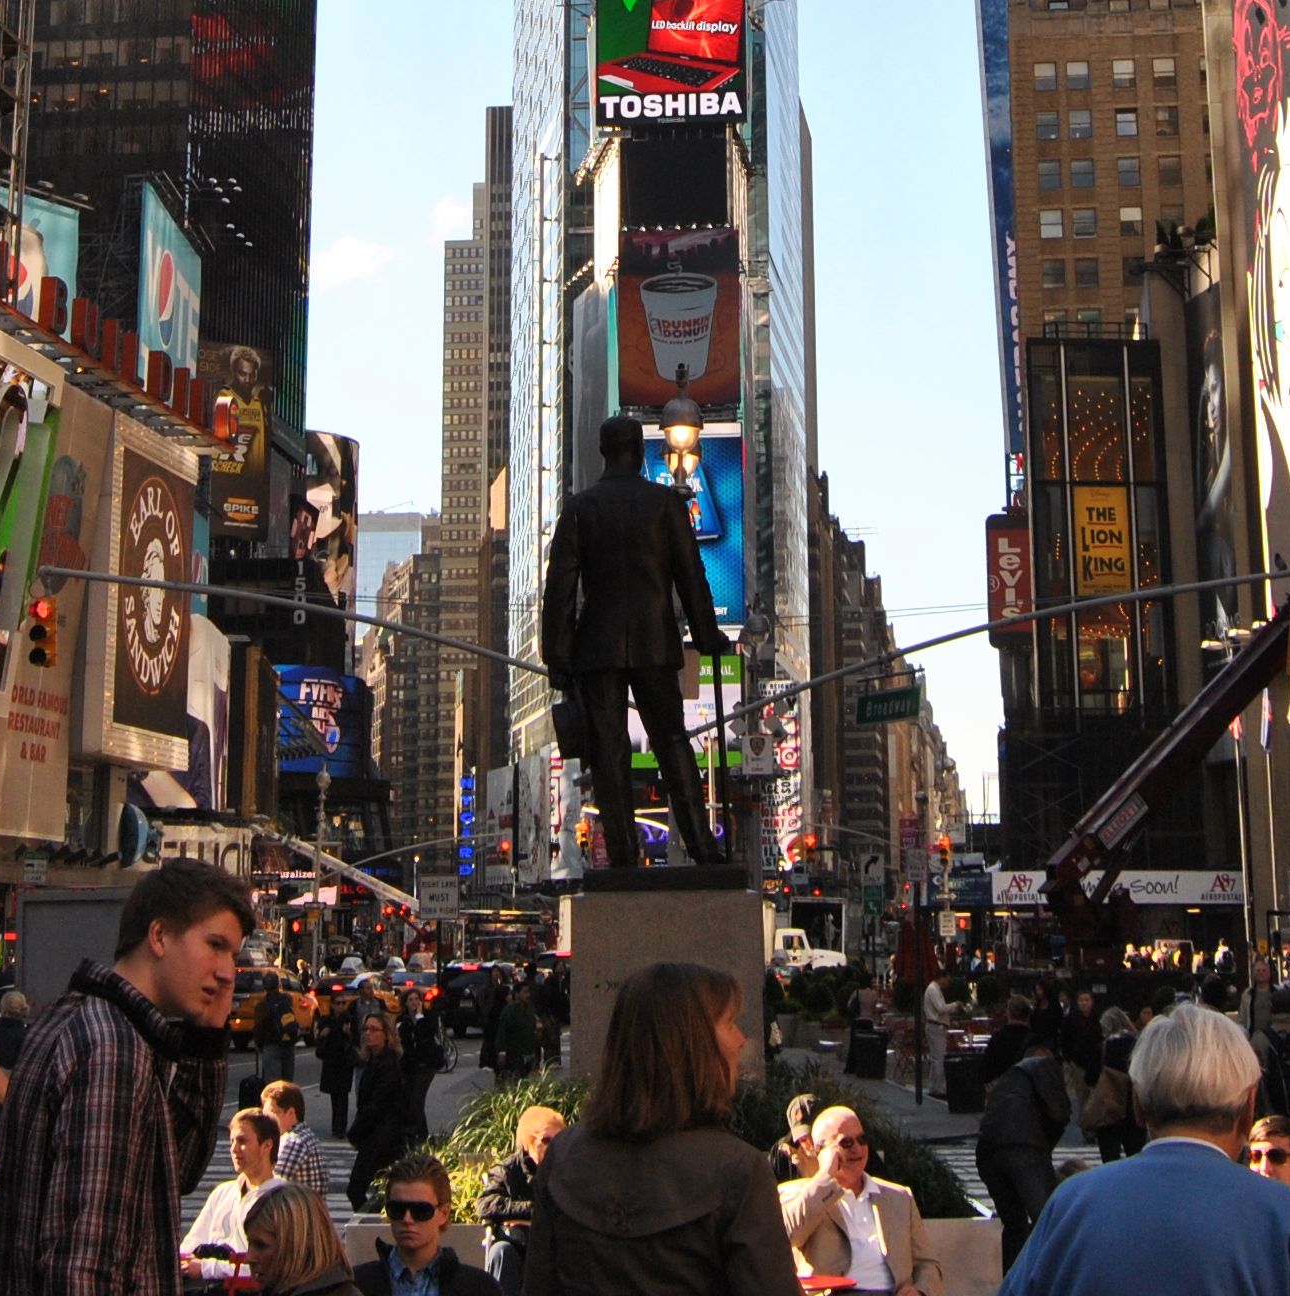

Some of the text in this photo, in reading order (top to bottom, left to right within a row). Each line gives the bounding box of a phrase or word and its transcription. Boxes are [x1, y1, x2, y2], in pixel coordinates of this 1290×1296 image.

[651, 19, 738, 36] LED backlit display
[599, 91, 743, 120] TOSHIBA
[129, 486, 165, 547] EARL
[223, 502, 259, 514] SPIKE
[1085, 506, 1117, 523] THE
[1080, 526, 1124, 553] LION
[1081, 555, 1126, 583] KING
[124, 594, 181, 688] SANDWICH
[866, 699, 910, 718] Broadway
[8, 711, 61, 741] RESTAURANT
[20, 741, 47, 764] & BAR
[421, 880, 457, 889] RIGHT LANE
[429, 893, 450, 903] MUST
[439, 907, 457, 915] RIGHT
